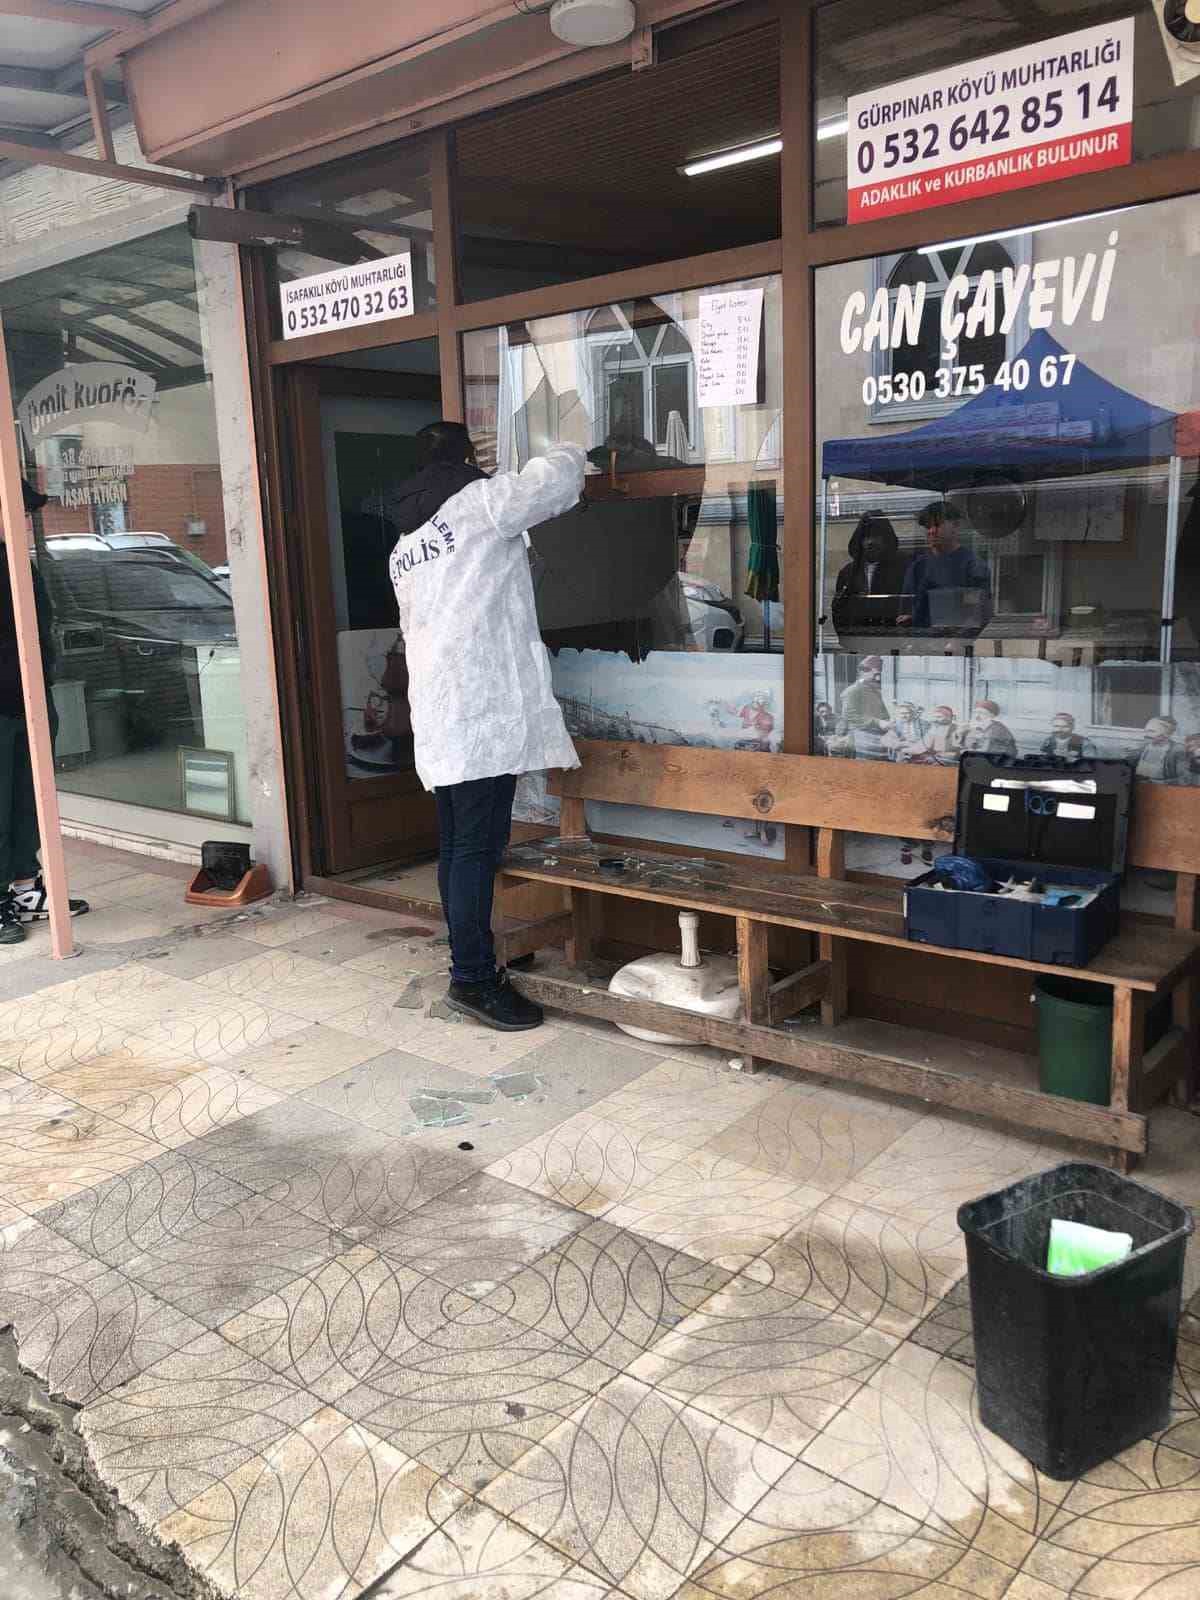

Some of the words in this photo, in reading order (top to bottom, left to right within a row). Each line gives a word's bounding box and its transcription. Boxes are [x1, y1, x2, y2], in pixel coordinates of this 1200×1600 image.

[857, 89, 943, 130] GÜRPINAR
[946, 70, 996, 107] KÖYÜ
[1001, 38, 1122, 92] MUHTARLIĞI
[857, 140, 875, 175] 0
[883, 123, 940, 168] 532
[949, 104, 1011, 152] 642
[1020, 89, 1063, 134] 85
[1076, 75, 1121, 120] 14
[860, 177, 922, 208] ADAKLIK
[924, 176, 941, 193] ve
[943, 151, 1034, 189] KURBANLIK
[1036, 132, 1119, 168] BULUNUR
[287, 309, 297, 331] 0
[300, 303, 328, 329] 532
[331, 295, 360, 321] 470
[363, 290, 384, 316] 32
[387, 285, 409, 311] 63
[325, 274, 349, 294] KÖYÜ
[350, 263, 406, 291] MUHTARLIĞI
[839, 280, 927, 355] CAN
[940, 230, 1119, 361] ÇAYEVİ
[862, 369, 926, 406] 0530
[934, 363, 986, 399] 375
[993, 358, 1030, 392] 40
[1040, 353, 1077, 388] 67
[396, 538, 441, 578] POLİS
